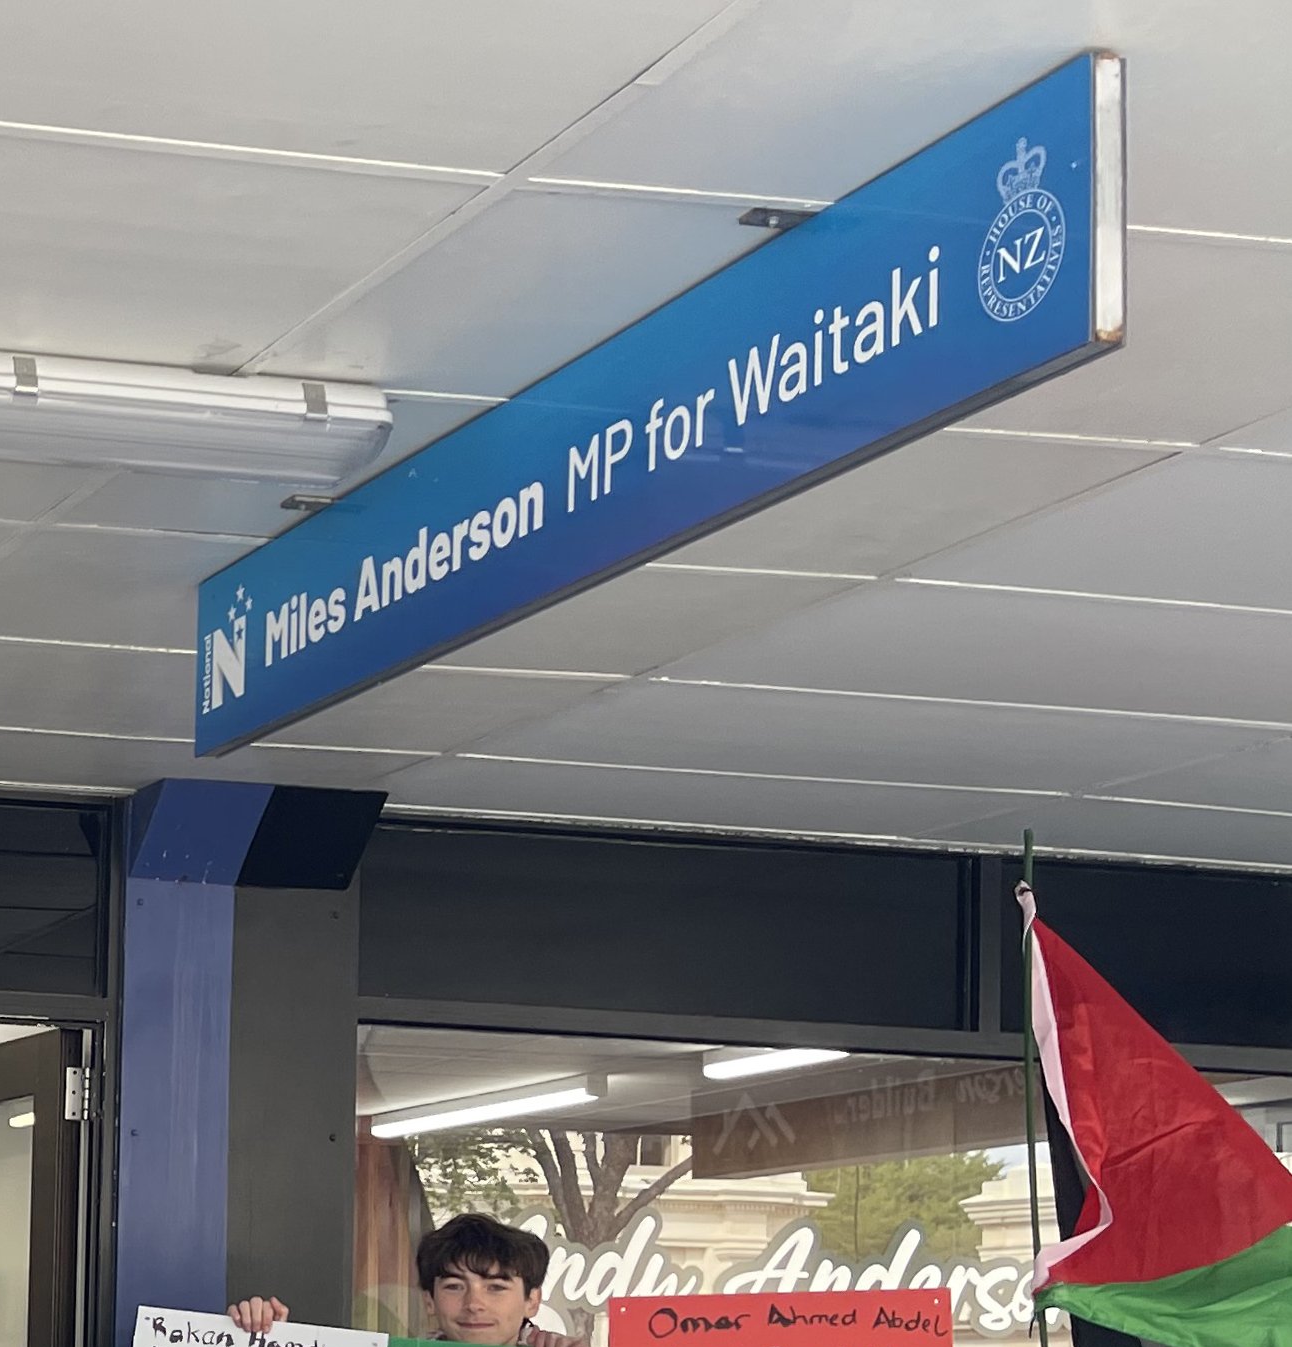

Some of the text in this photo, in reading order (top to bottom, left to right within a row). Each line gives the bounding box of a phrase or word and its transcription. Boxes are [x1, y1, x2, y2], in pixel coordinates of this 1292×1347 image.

[988, 194, 1055, 242] HOUSE OF
[996, 226, 1047, 283] NZ
[265, 246, 941, 668] Miles Anderson MP for Waitaki
[201, 633, 215, 715] National
[767, 1303, 858, 1328] Ahmed
[872, 1306, 949, 1338] Abdel
